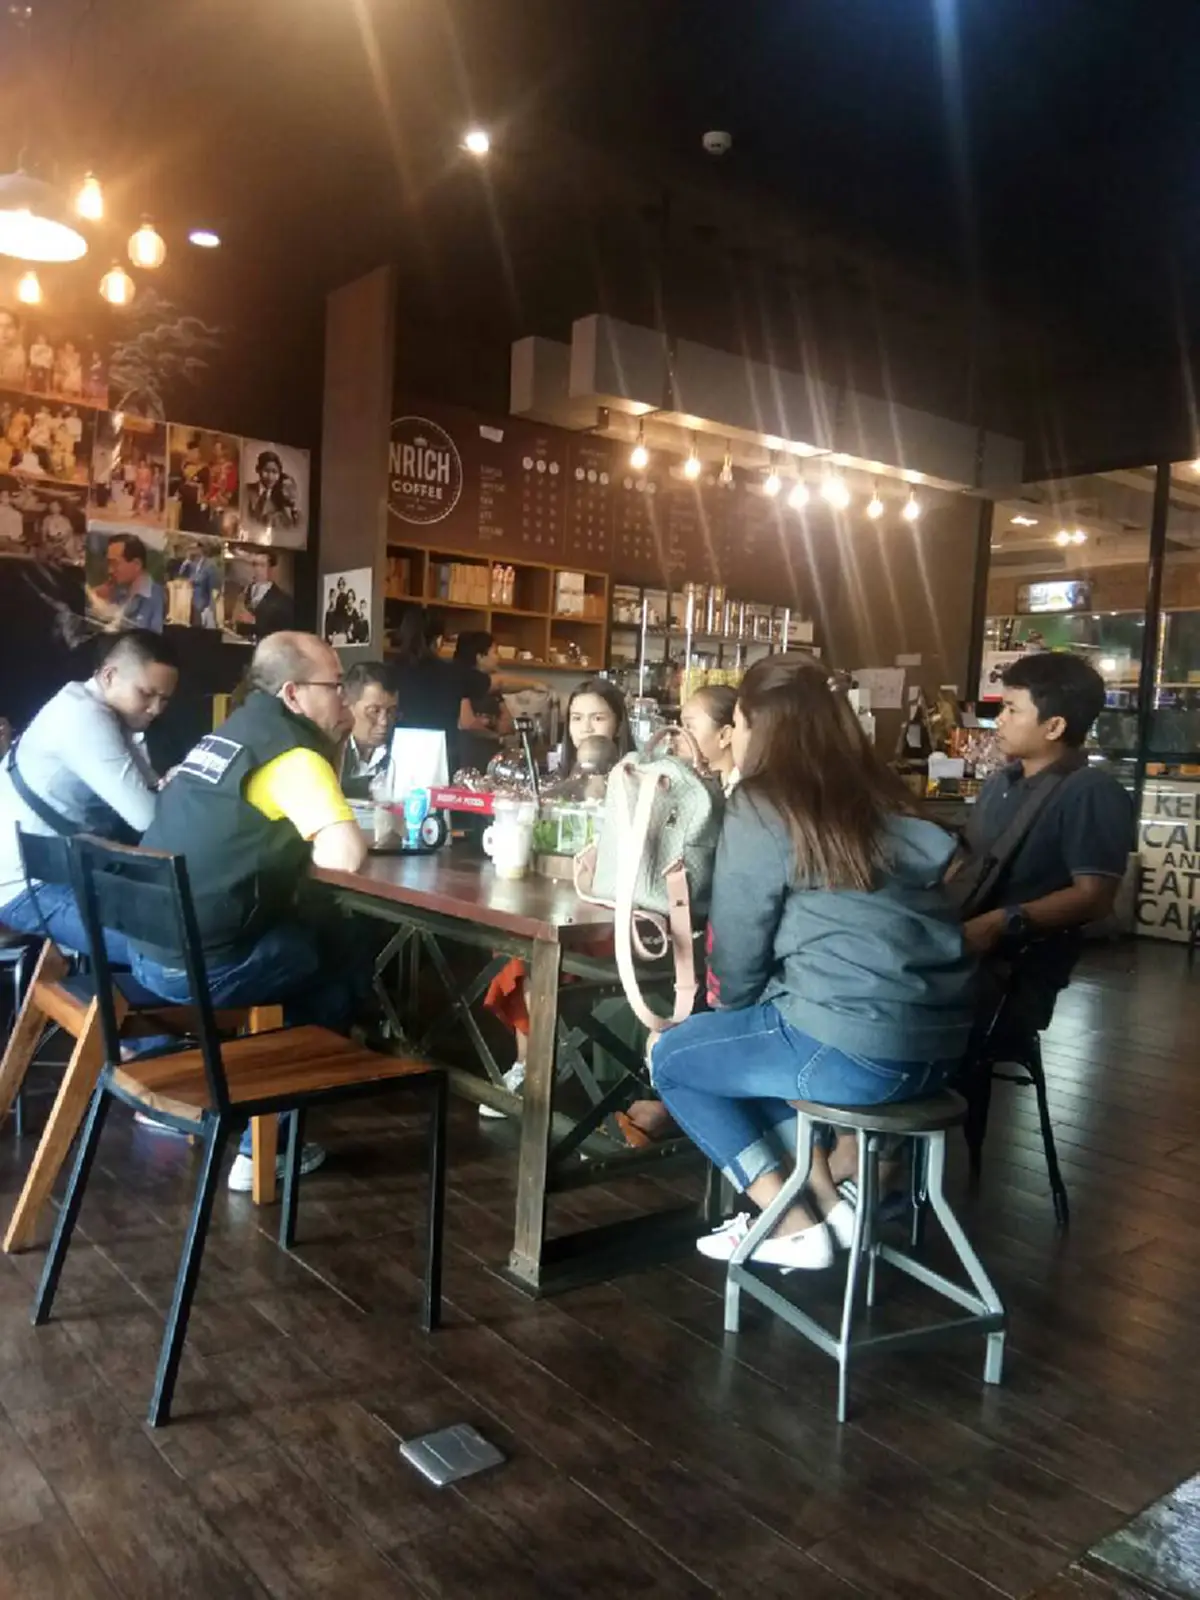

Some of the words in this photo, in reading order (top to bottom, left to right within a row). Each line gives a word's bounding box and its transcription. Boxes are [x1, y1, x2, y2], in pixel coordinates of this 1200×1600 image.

[392, 480, 442, 500] COFFEE
[1154, 790, 1200, 820] KE
[1142, 824, 1200, 852] CA
[1162, 851, 1200, 870] AN
[1139, 866, 1200, 899] EAT
